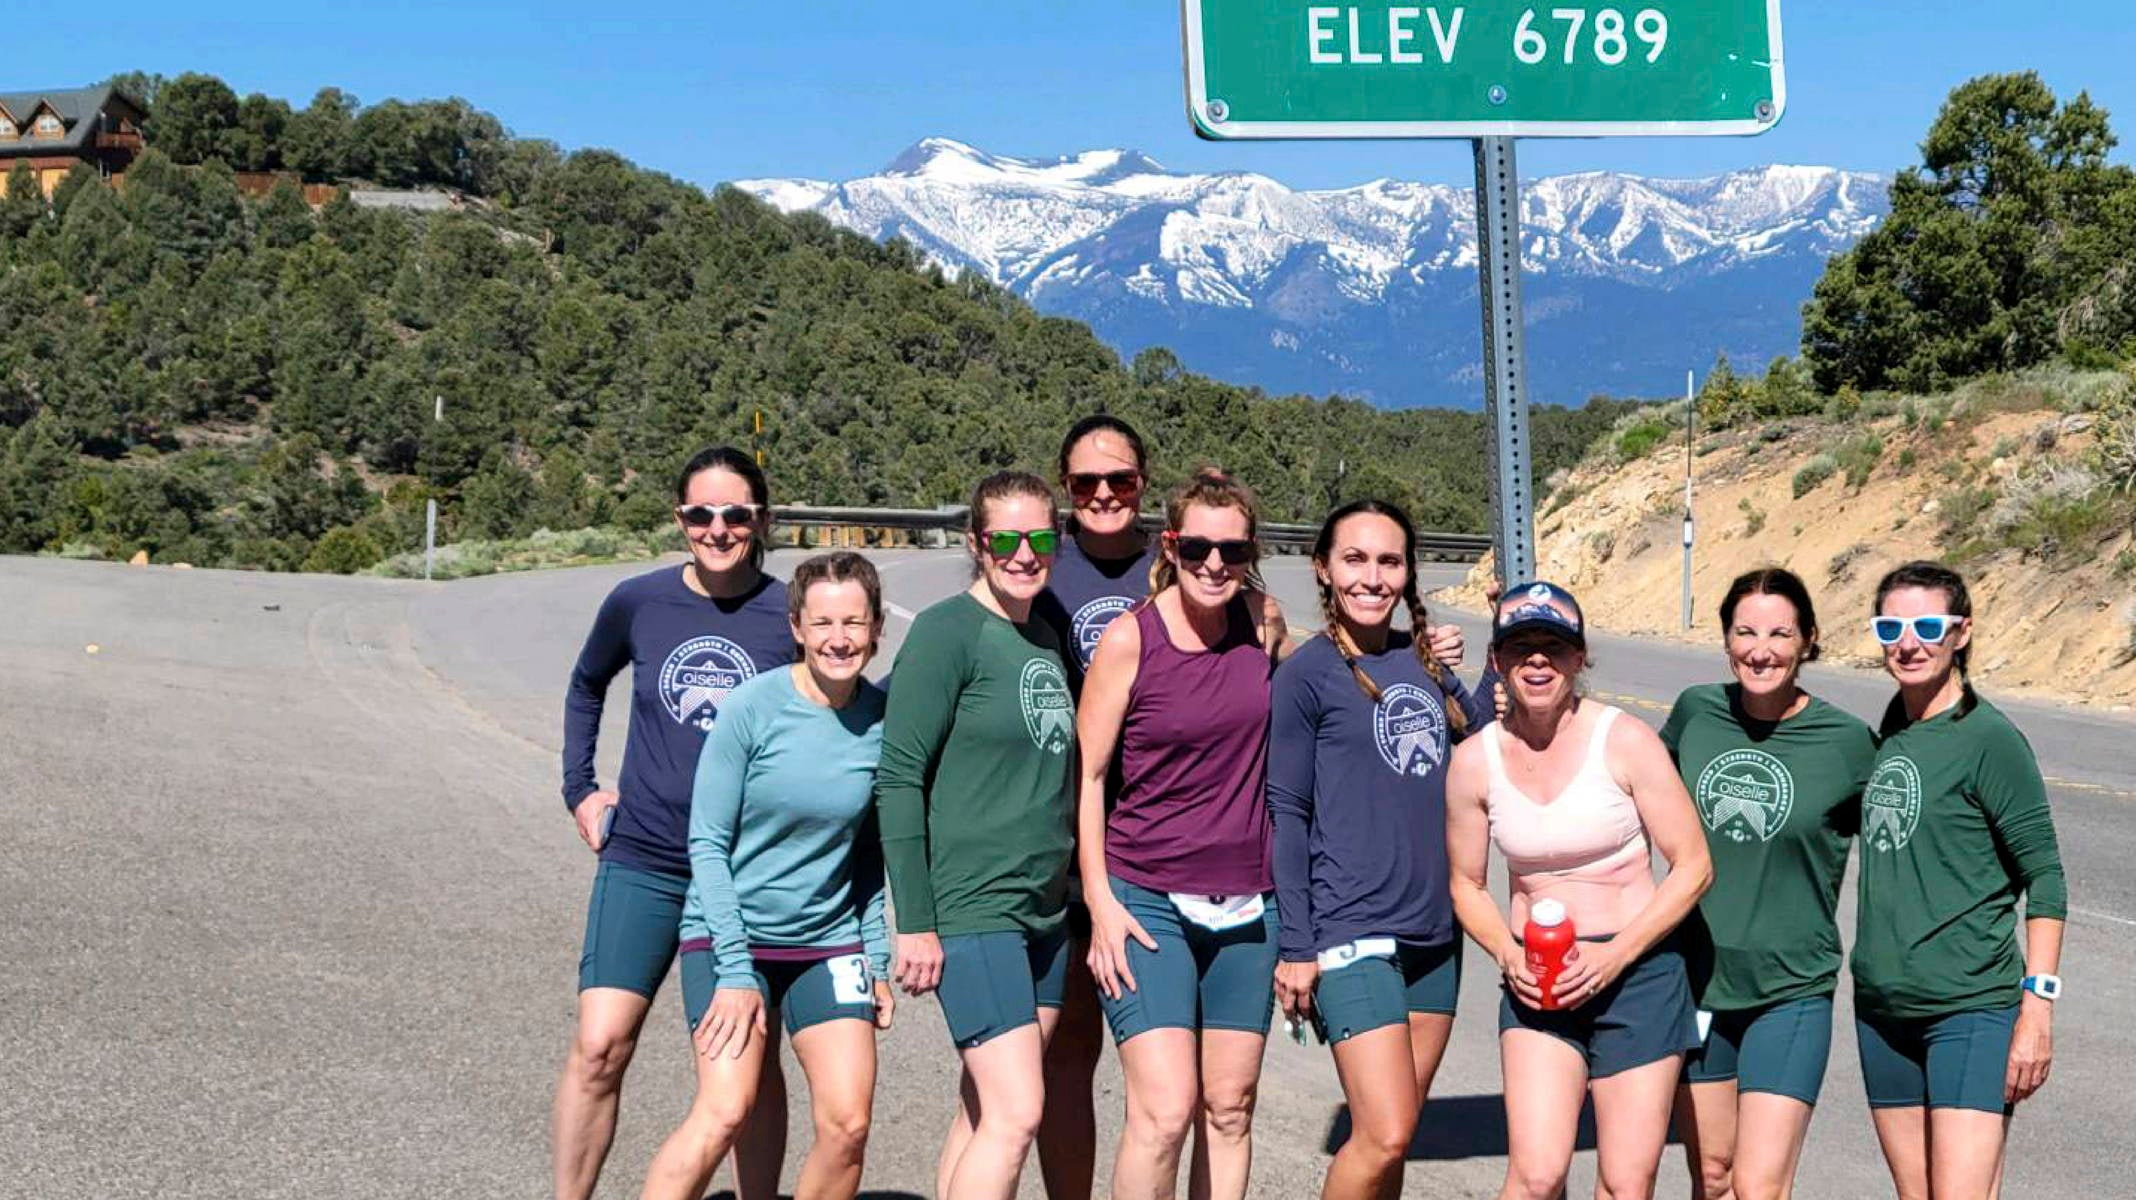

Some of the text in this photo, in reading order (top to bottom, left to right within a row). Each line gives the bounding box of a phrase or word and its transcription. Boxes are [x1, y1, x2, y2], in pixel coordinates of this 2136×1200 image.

[1308, 7, 1669, 66] ELEV 6789
[682, 671, 735, 688] oiselle
[1719, 781, 1769, 801] oiselle
[850, 958, 869, 995] 3
